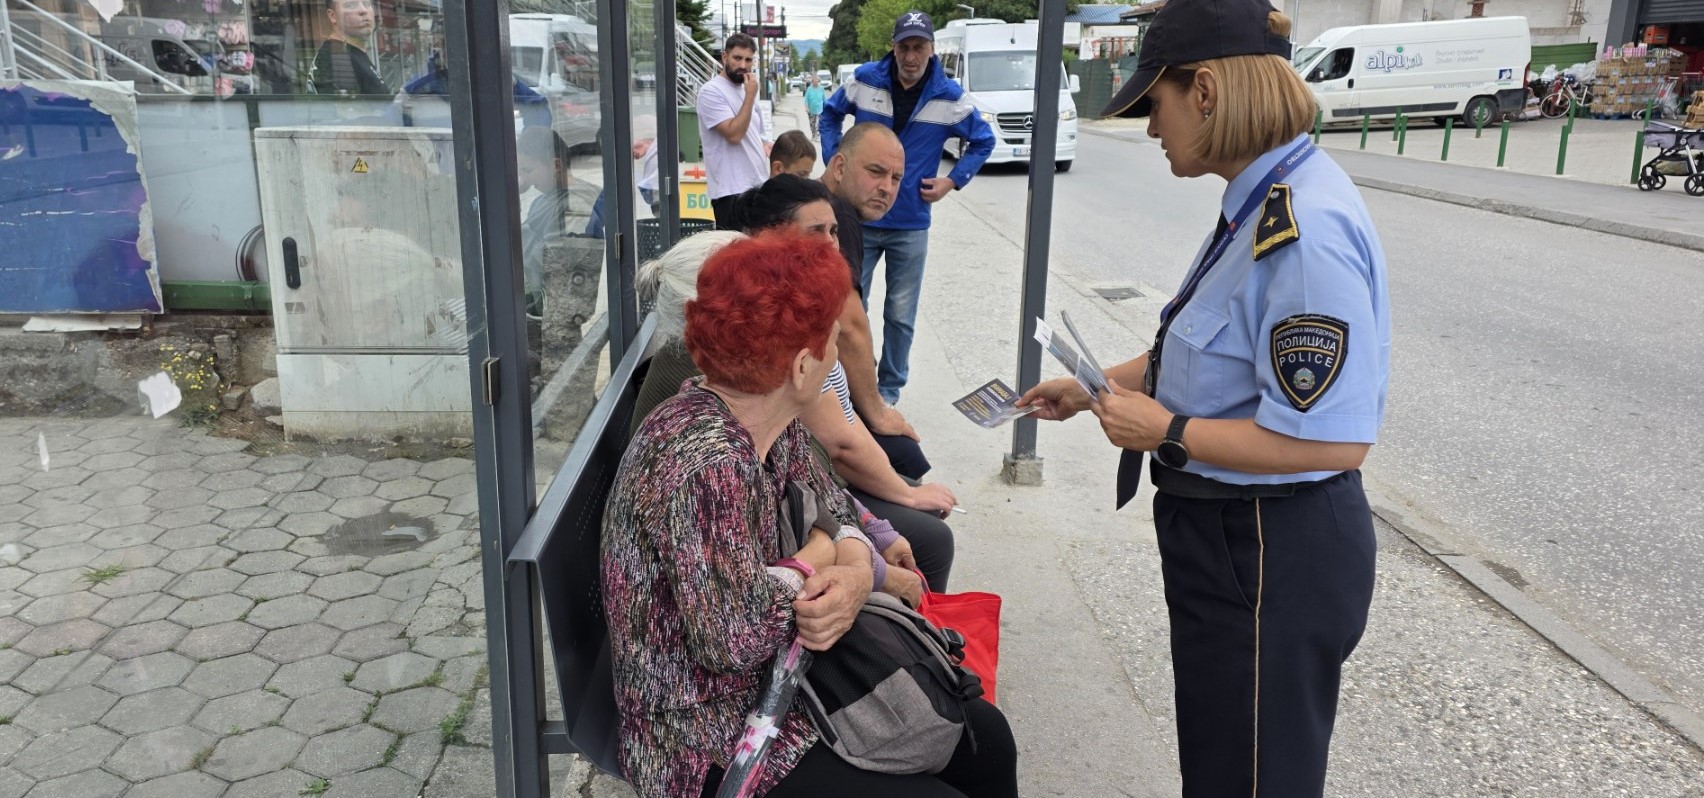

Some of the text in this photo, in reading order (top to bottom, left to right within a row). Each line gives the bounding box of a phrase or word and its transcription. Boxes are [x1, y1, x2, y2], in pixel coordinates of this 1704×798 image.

[1366, 46, 1404, 73] alpi
[687, 193, 712, 209] БО
[1303, 327, 1340, 340] МАКЕДОНИЈА
[1277, 336, 1336, 352] ПОЛИЦИЈА
[1279, 352, 1334, 368] POLICE
